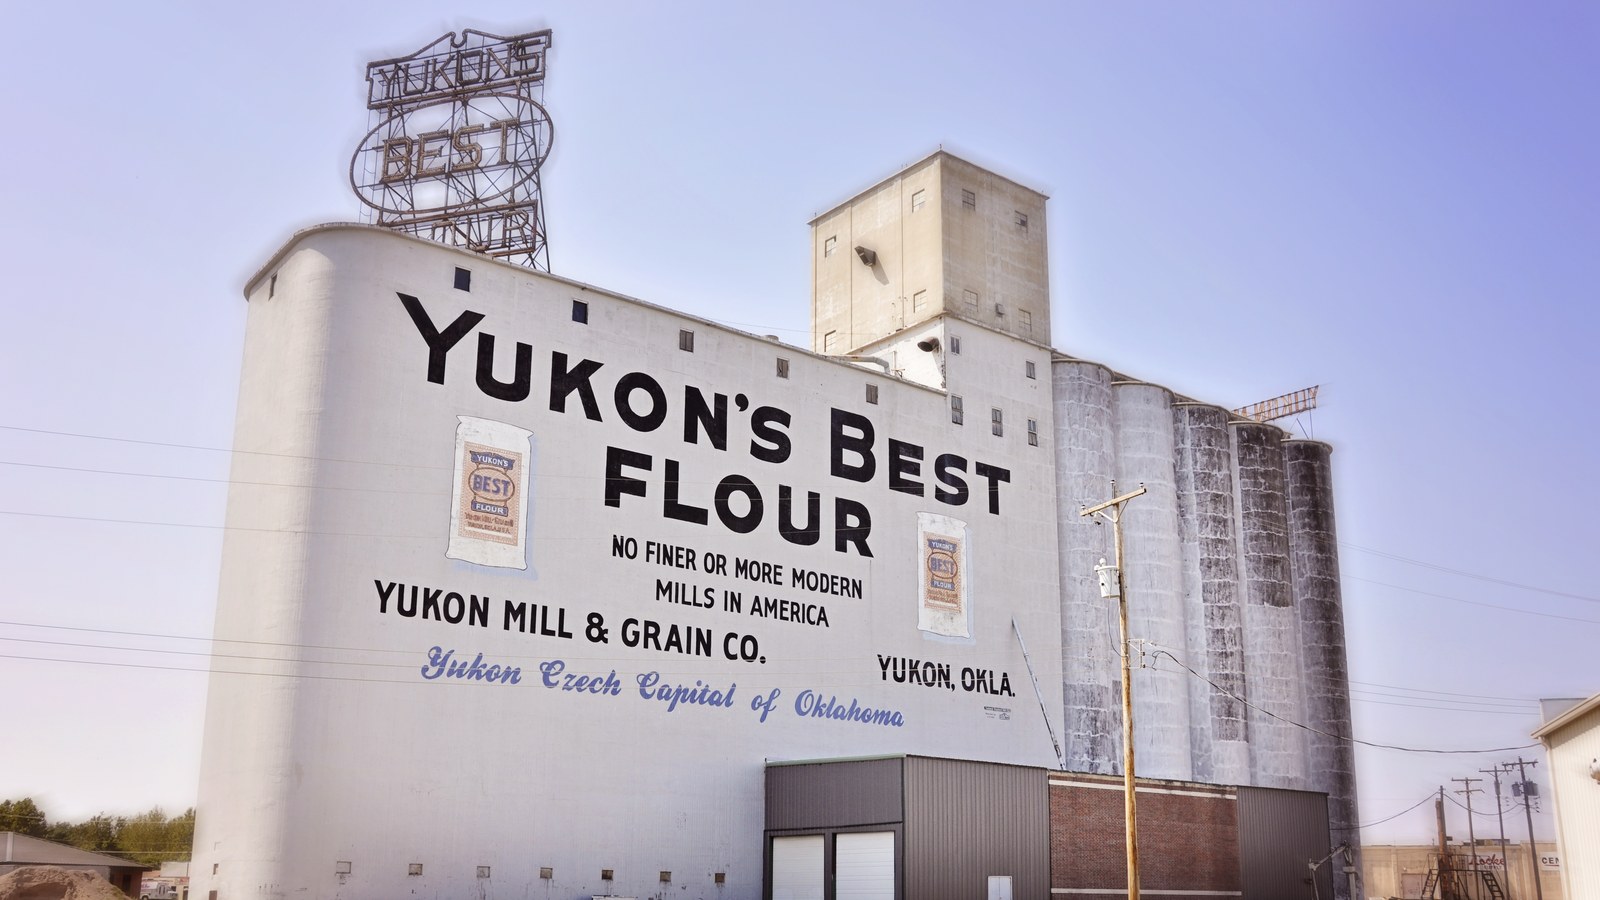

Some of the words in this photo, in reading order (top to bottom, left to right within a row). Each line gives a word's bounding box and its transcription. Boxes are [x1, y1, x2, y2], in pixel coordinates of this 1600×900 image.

[379, 118, 519, 184] BEST
[395, 291, 792, 464] YUKON'S
[830, 407, 1011, 516] BEST
[473, 474, 510, 496] BEST
[477, 455, 508, 466] YUKON'S
[476, 504, 503, 513] FLOUR
[604, 445, 874, 558] FLOUR
[612, 534, 638, 560] NO
[645, 541, 697, 571] FINER
[703, 552, 728, 577] OR
[735, 557, 783, 586] MORE
[792, 567, 863, 600] MODERN
[931, 558, 953, 575] BEST
[374, 579, 490, 628] YUKON
[503, 599, 573, 640] MILL
[585, 612, 609, 644] &
[621, 617, 712, 658] GRAIN
[723, 632, 767, 665] CO.
[655, 578, 715, 609] MILLS
[723, 590, 742, 614] IN
[749, 595, 830, 628] AMERICA
[421, 646, 522, 686] Yukon
[539, 660, 622, 696] Czech
[636, 671, 737, 713] Capital
[750, 687, 781, 723] of
[794, 689, 905, 728] Oklahoma
[877, 654, 956, 692] YUKON,
[961, 667, 1016, 698] OKLA.
